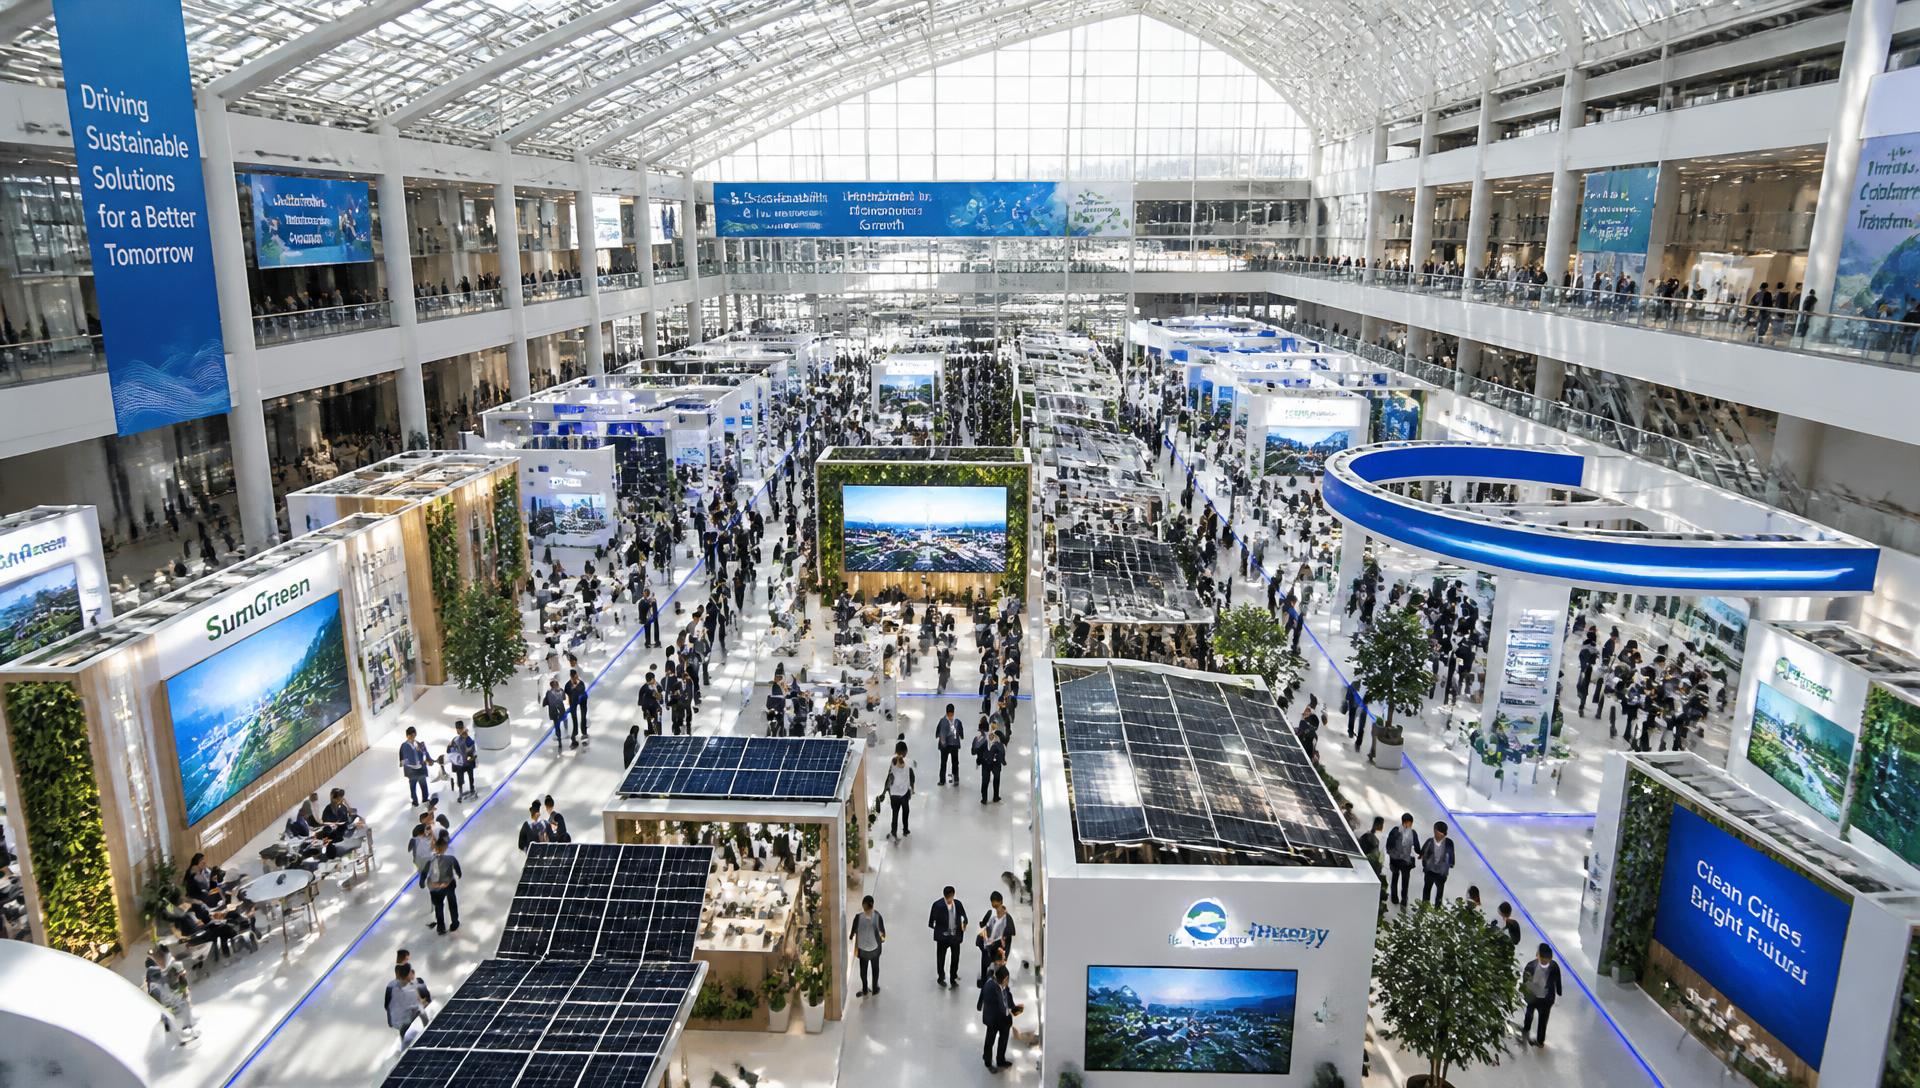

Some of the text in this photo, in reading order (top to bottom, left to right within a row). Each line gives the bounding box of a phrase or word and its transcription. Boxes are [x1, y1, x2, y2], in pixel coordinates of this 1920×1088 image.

[80, 84, 149, 123] Driving
[86, 125, 189, 158] Sustainable
[92, 165, 175, 192] Solutions
[98, 204, 196, 229] for a Better
[104, 243, 194, 266] Tomorrow
